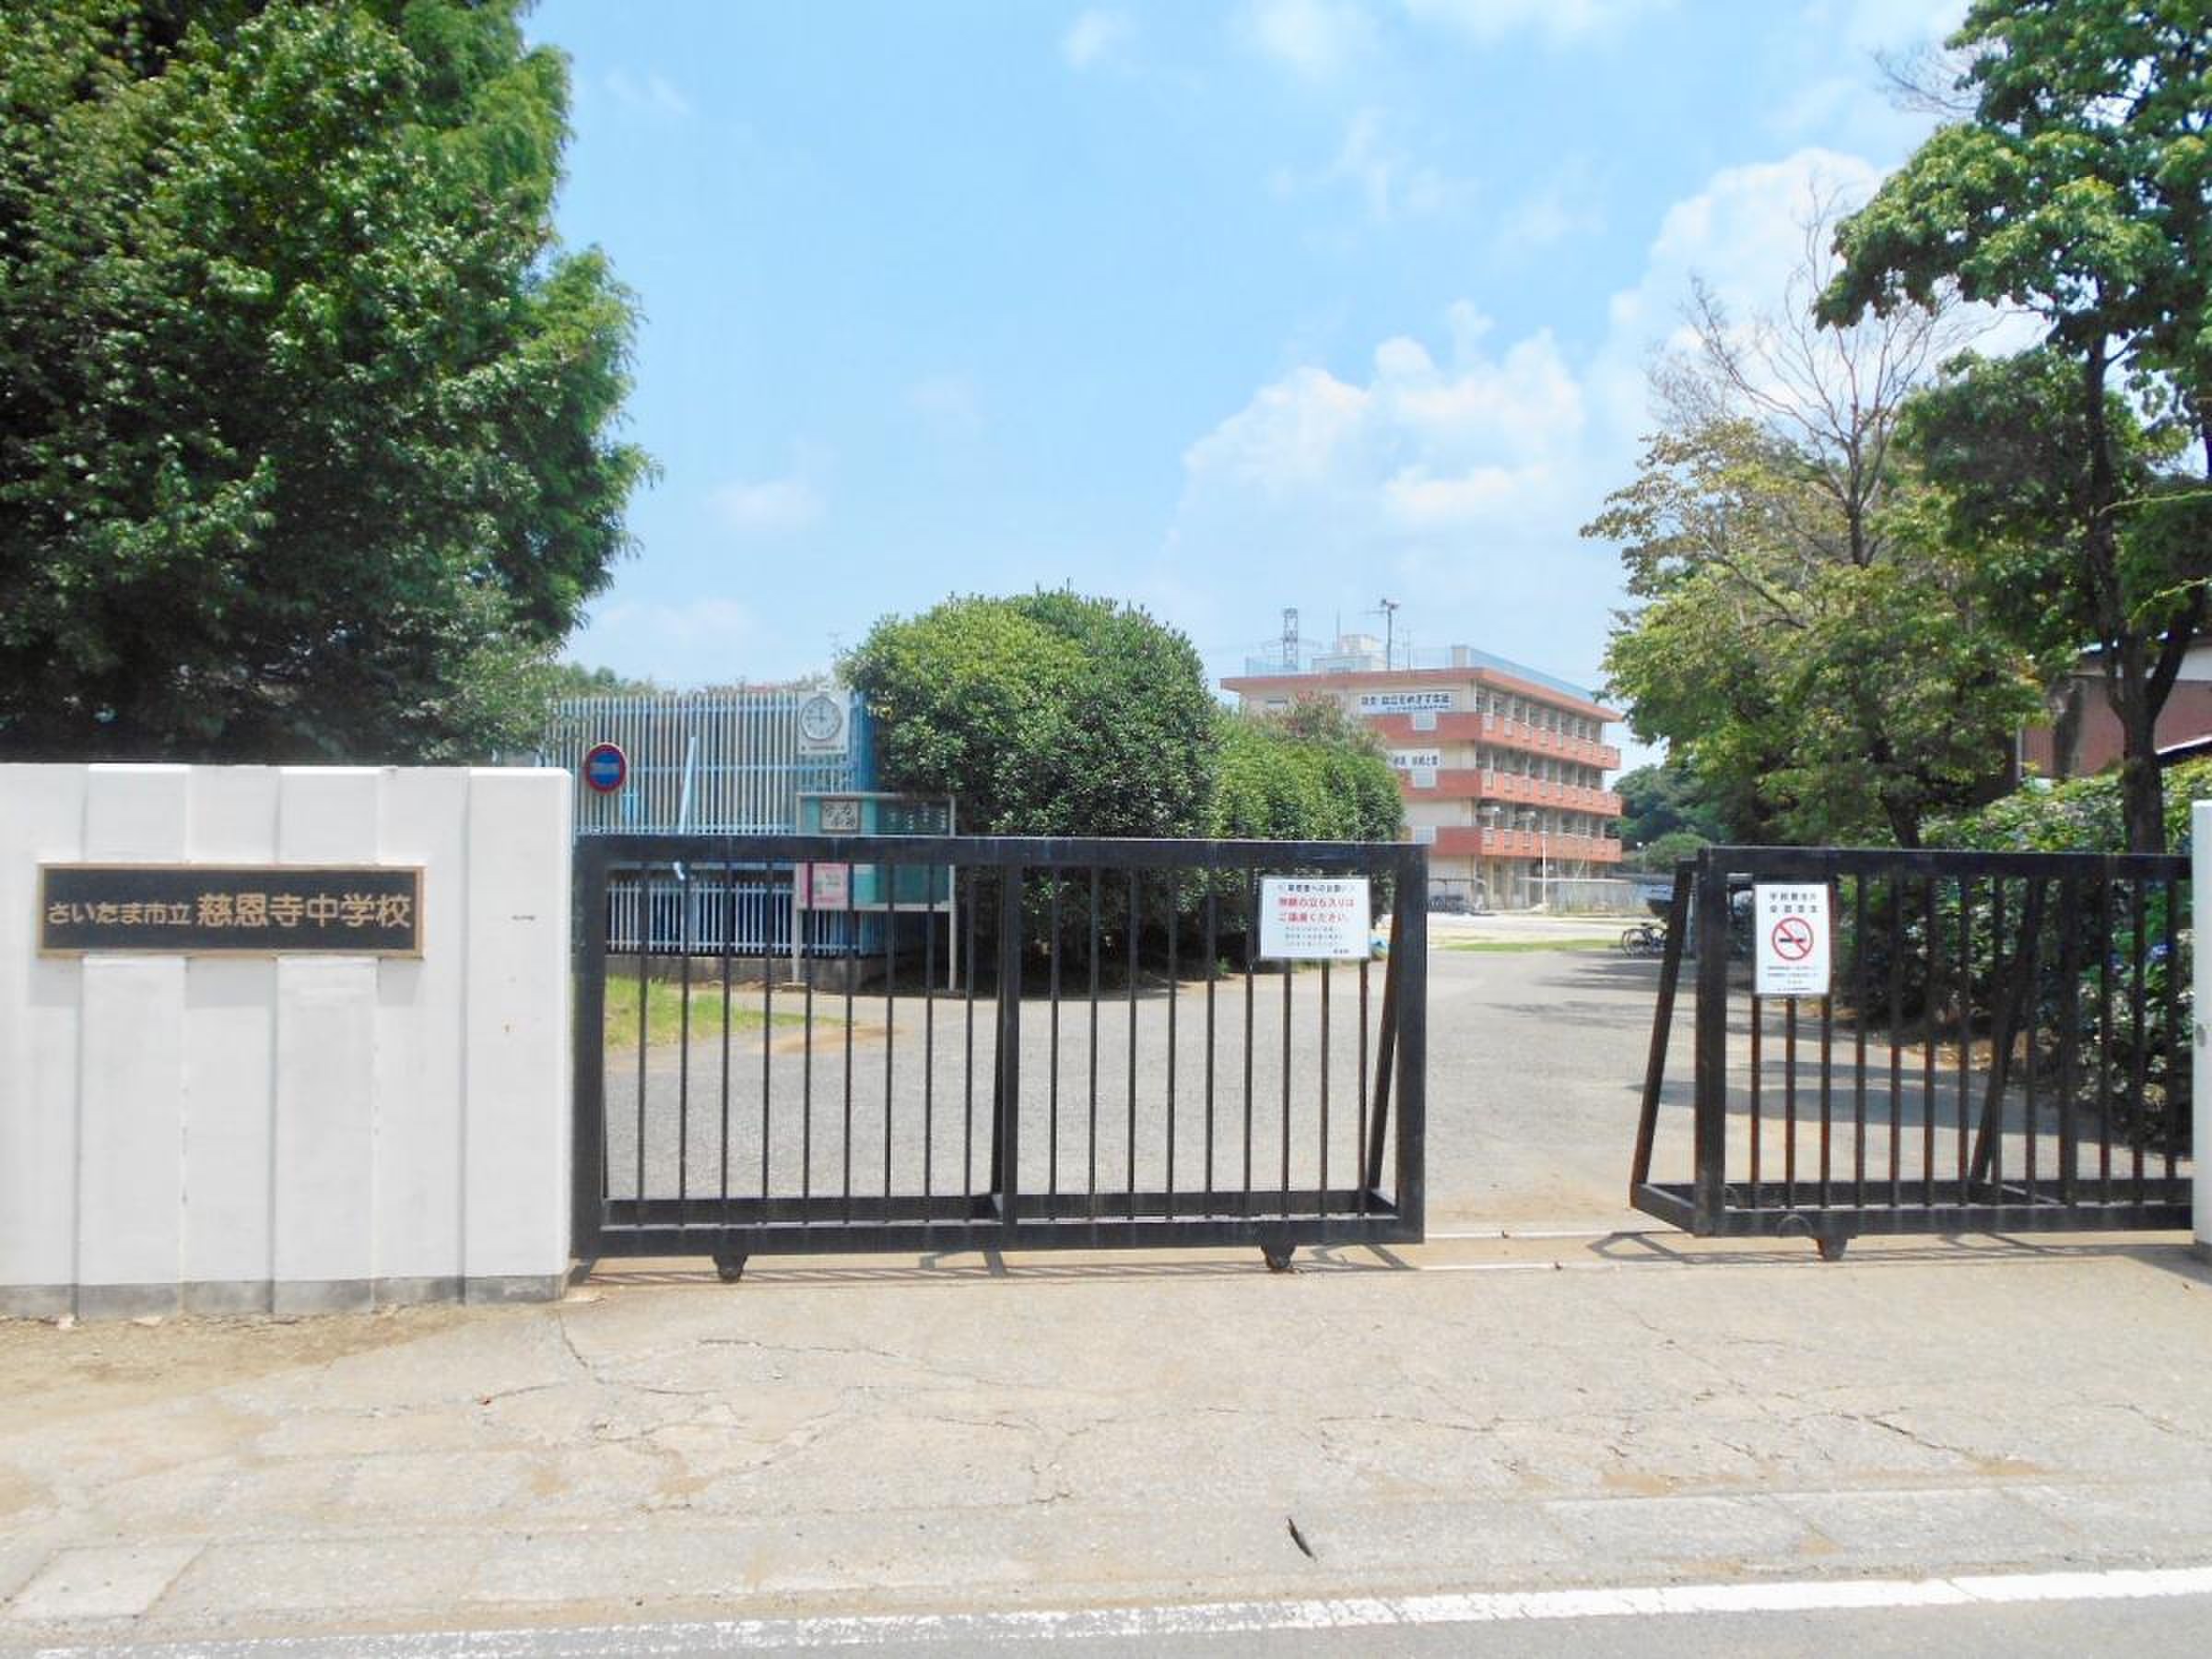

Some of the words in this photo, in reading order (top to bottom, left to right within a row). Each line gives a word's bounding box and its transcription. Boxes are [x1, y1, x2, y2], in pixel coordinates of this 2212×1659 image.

[47, 901, 192, 925] さいたま市立
[196, 892, 412, 928] 慈恩寺中学校
